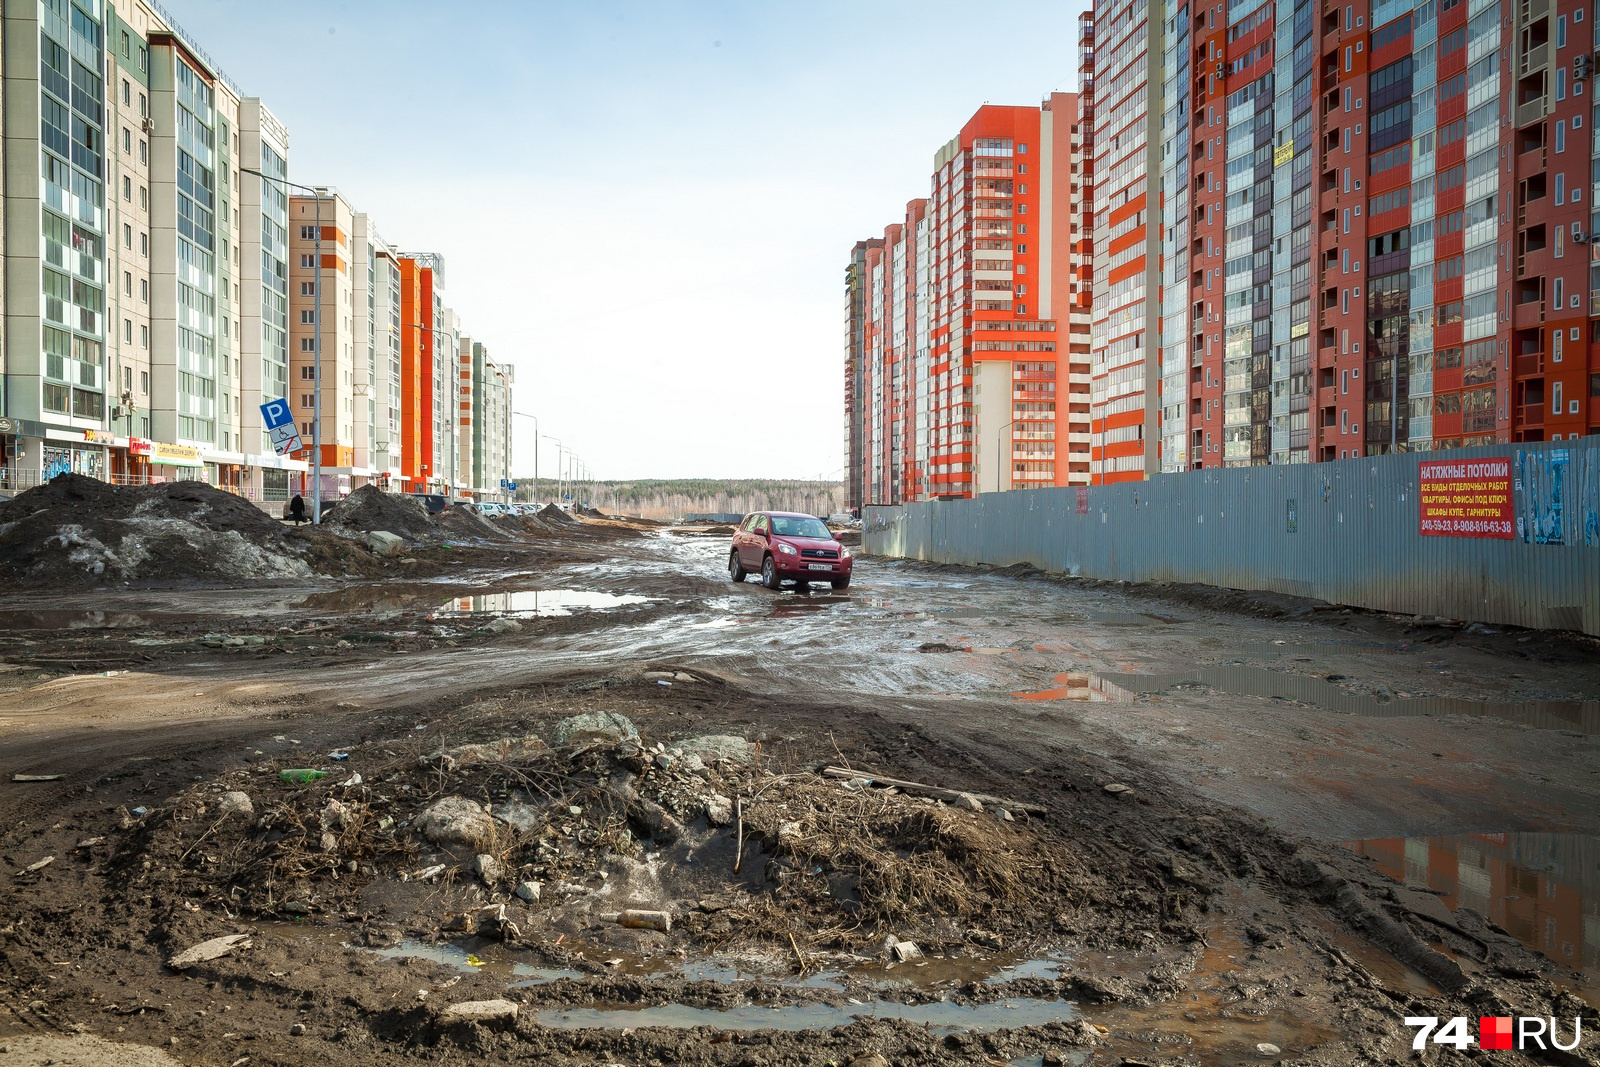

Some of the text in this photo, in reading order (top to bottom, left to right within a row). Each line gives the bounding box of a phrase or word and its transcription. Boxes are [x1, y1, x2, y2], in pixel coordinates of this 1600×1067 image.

[266, 404, 282, 426] P
[1421, 462, 1508, 479] НАТЯЖНЫЕ ПОТОЛКИ
[1432, 483, 1447, 492] ВИДЫ
[1449, 482, 1487, 492] ОТДЕЛОЧНЫХ
[1489, 482, 1508, 491] РАБОТ
[1422, 495, 1507, 505] КВАРТИРЫ, ОФИСЫ ПОД КЛЮЧ
[1449, 508, 1465, 518] КУПЕ,
[1467, 508, 1501, 517] ГАРНИТУРЫ
[1454, 520, 1511, 533] 8-908-816-63-38
